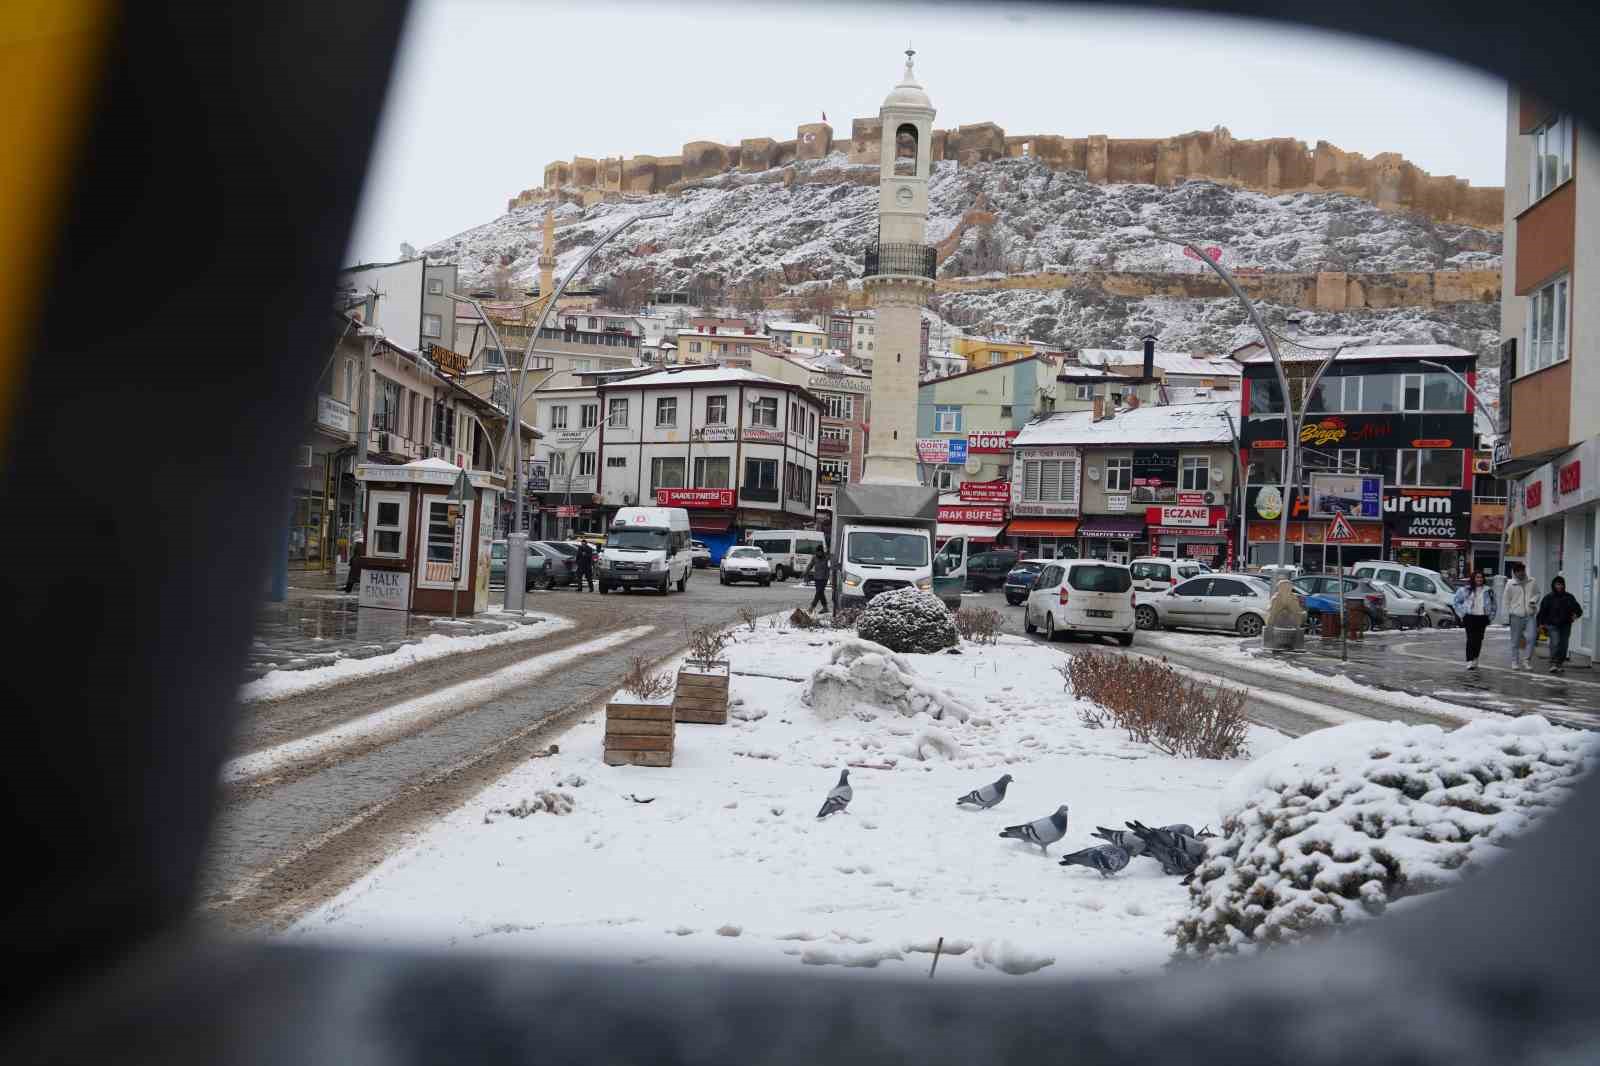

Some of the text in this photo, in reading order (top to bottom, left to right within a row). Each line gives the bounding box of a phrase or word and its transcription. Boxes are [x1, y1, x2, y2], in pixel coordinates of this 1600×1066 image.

[1164, 509, 1207, 519] ECZANE
[1412, 518, 1453, 527] AKTAR
[1408, 526, 1456, 537] KOKOÇ
[370, 573, 400, 586] HALK
